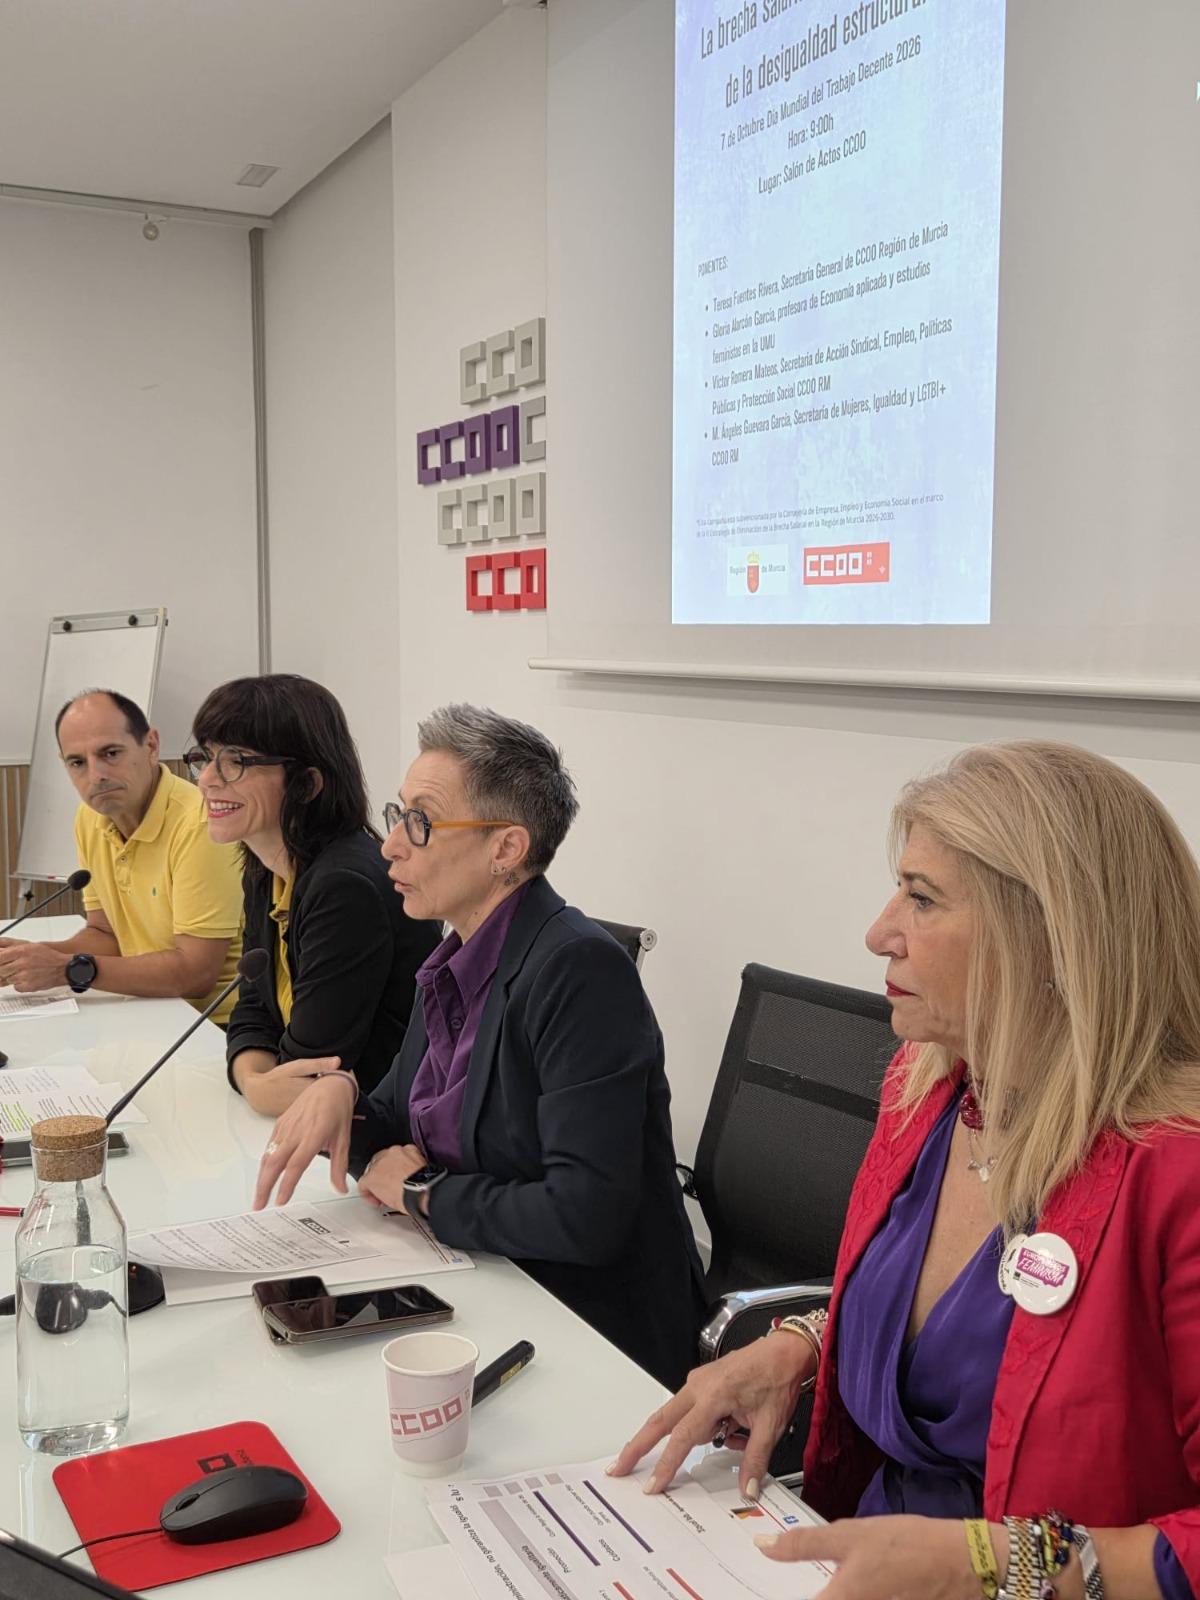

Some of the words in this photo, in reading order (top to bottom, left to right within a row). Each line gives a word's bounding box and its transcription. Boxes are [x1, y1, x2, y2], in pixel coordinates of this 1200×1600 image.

[701, 27, 713, 59] La
[718, 0, 757, 50] brecha
[726, 73, 739, 108] de
[742, 65, 753, 99] la
[758, 14, 837, 90] desigualdad
[720, 133, 726, 151] 7
[727, 130, 736, 148] de
[736, 117, 765, 143] Octubre
[780, 90, 810, 121] Mundial
[811, 83, 824, 106] del
[826, 72, 855, 99] Trabajo
[858, 51, 893, 82] Decente
[896, 34, 921, 64] 2026
[788, 127, 808, 150] Hora:
[810, 113, 834, 139] 9:00h
[758, 173, 782, 194] Lugar:
[783, 160, 804, 184] Salón
[806, 153, 816, 174] de
[818, 146, 841, 169] Actos
[843, 130, 866, 158] CCOO
[713, 295, 733, 313] Teresa
[733, 287, 757, 306] Fuentes
[758, 280, 780, 298] Rivera,
[816, 256, 843, 279] General
[845, 252, 853, 270] de
[855, 243, 877, 266] CCOO
[879, 236, 906, 260] Región
[909, 232, 920, 250] de
[922, 220, 948, 246] Murcia
[712, 321, 731, 338] Gloria
[777, 299, 808, 322] profesora
[809, 292, 819, 310] de
[820, 282, 854, 307] Economía
[856, 272, 887, 298] aplicada
[889, 272, 895, 289] y
[897, 261, 931, 284] estudios
[712, 343, 742, 364] feministas
[743, 343, 751, 356] en
[752, 338, 759, 353] la
[760, 333, 776, 352] UMU
[815, 348, 824, 365] de
[826, 342, 849, 362] Acción
[851, 333, 882, 356] Sindical,
[883, 326, 917, 348] Empleo,
[743, 419, 770, 435] Guevara
[831, 402, 840, 419] de
[841, 398, 871, 418] Mujeres,
[873, 387, 907, 413] Igualdad
[910, 390, 915, 407] y
[917, 380, 947, 403] LGTBI+
[777, 383, 796, 402] Social
[797, 377, 816, 397] CCOO
[818, 374, 831, 392] RM
[712, 450, 729, 466] CCOO
[730, 447, 739, 463] RM
